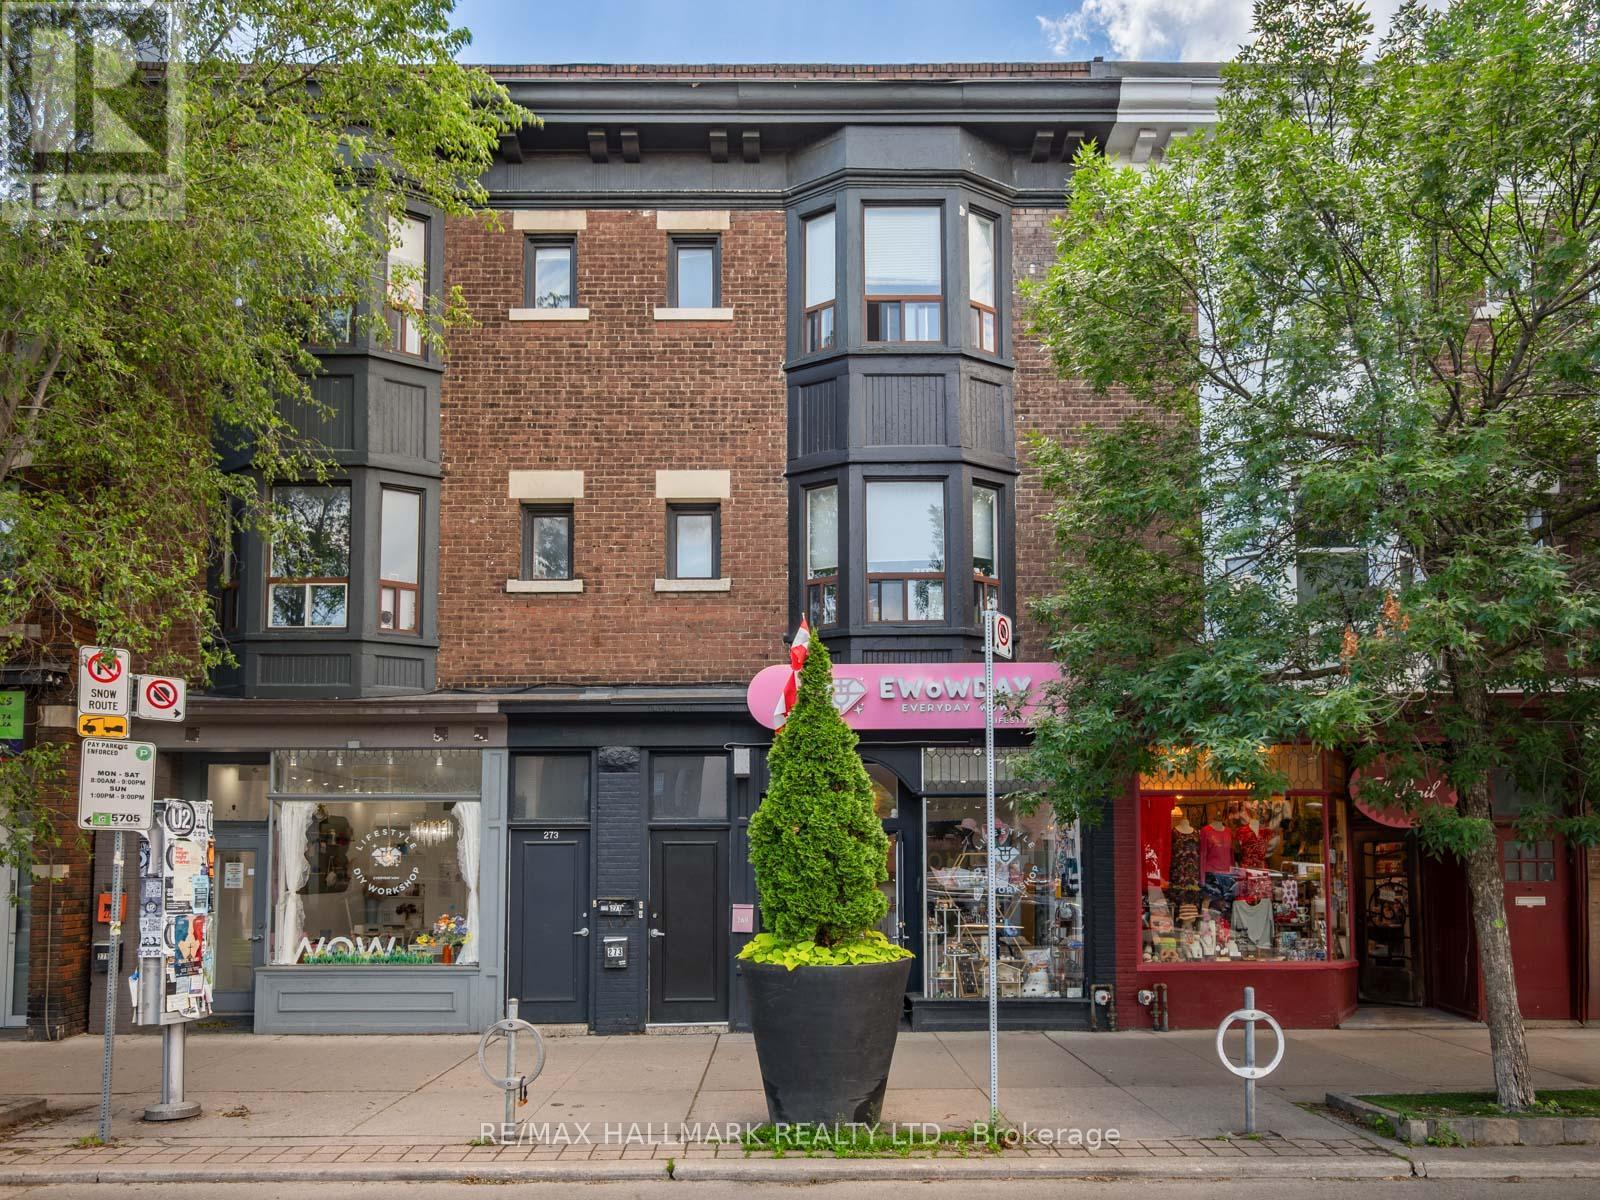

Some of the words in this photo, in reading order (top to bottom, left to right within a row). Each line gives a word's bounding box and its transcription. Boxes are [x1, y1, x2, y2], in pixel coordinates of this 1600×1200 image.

[91, 689, 117, 698] SNOW
[89, 700, 118, 711] ROUTE
[902, 703, 970, 712] EVERYDAY
[87, 748, 119, 756] ENFORCED
[111, 813, 141, 823] 5705
[171, 808, 191, 829] U2
[355, 829, 417, 851] LIFESTYLE
[543, 831, 559, 839] 273
[975, 828, 1036, 850] LIESTYLE
[353, 868, 368, 884] DIY
[367, 867, 419, 895] WORKSHOP
